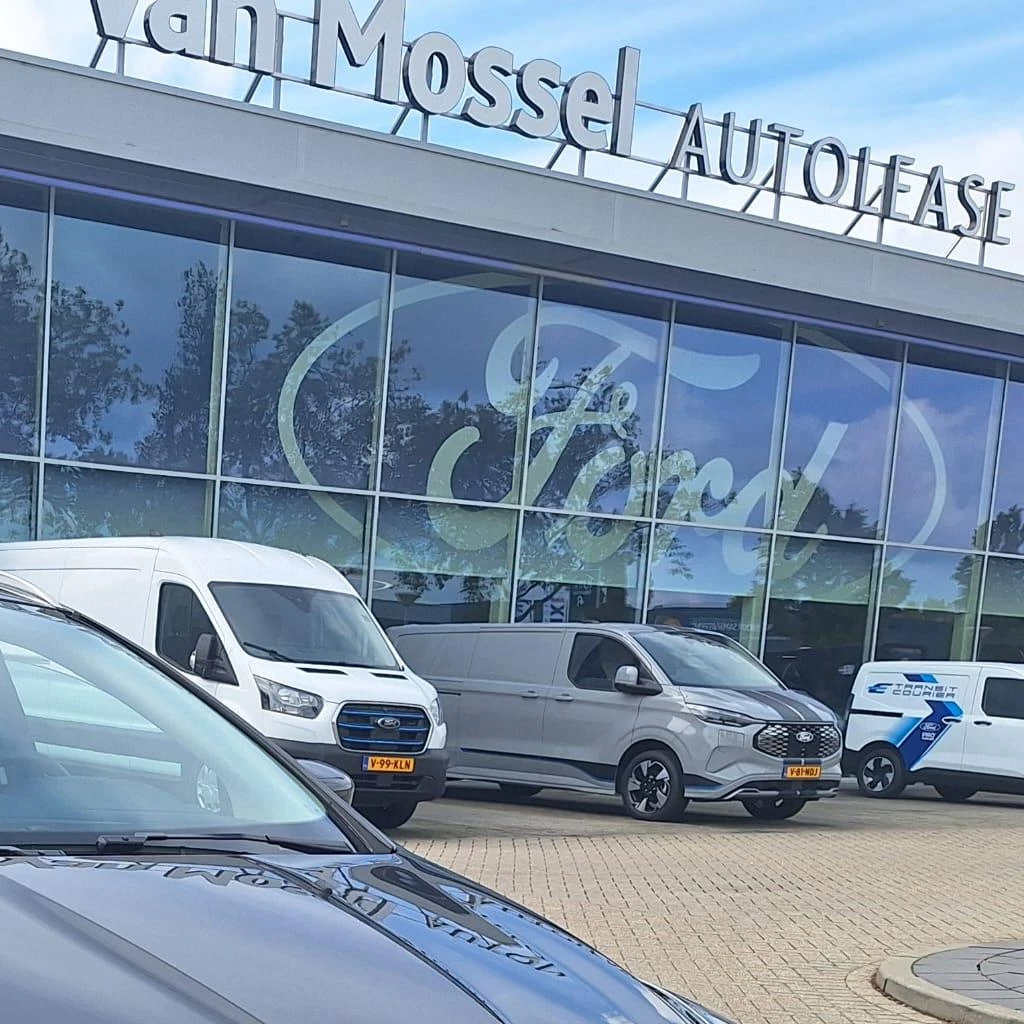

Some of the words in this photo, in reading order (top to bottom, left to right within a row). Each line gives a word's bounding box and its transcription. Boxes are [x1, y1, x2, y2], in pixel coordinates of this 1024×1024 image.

[310, 0, 640, 156] Mossel
[673, 102, 1016, 245] AUTOLEASE
[426, 307, 848, 580] Ford
[892, 689, 956, 699] COURIER
[896, 683, 958, 692] TRANSIT
